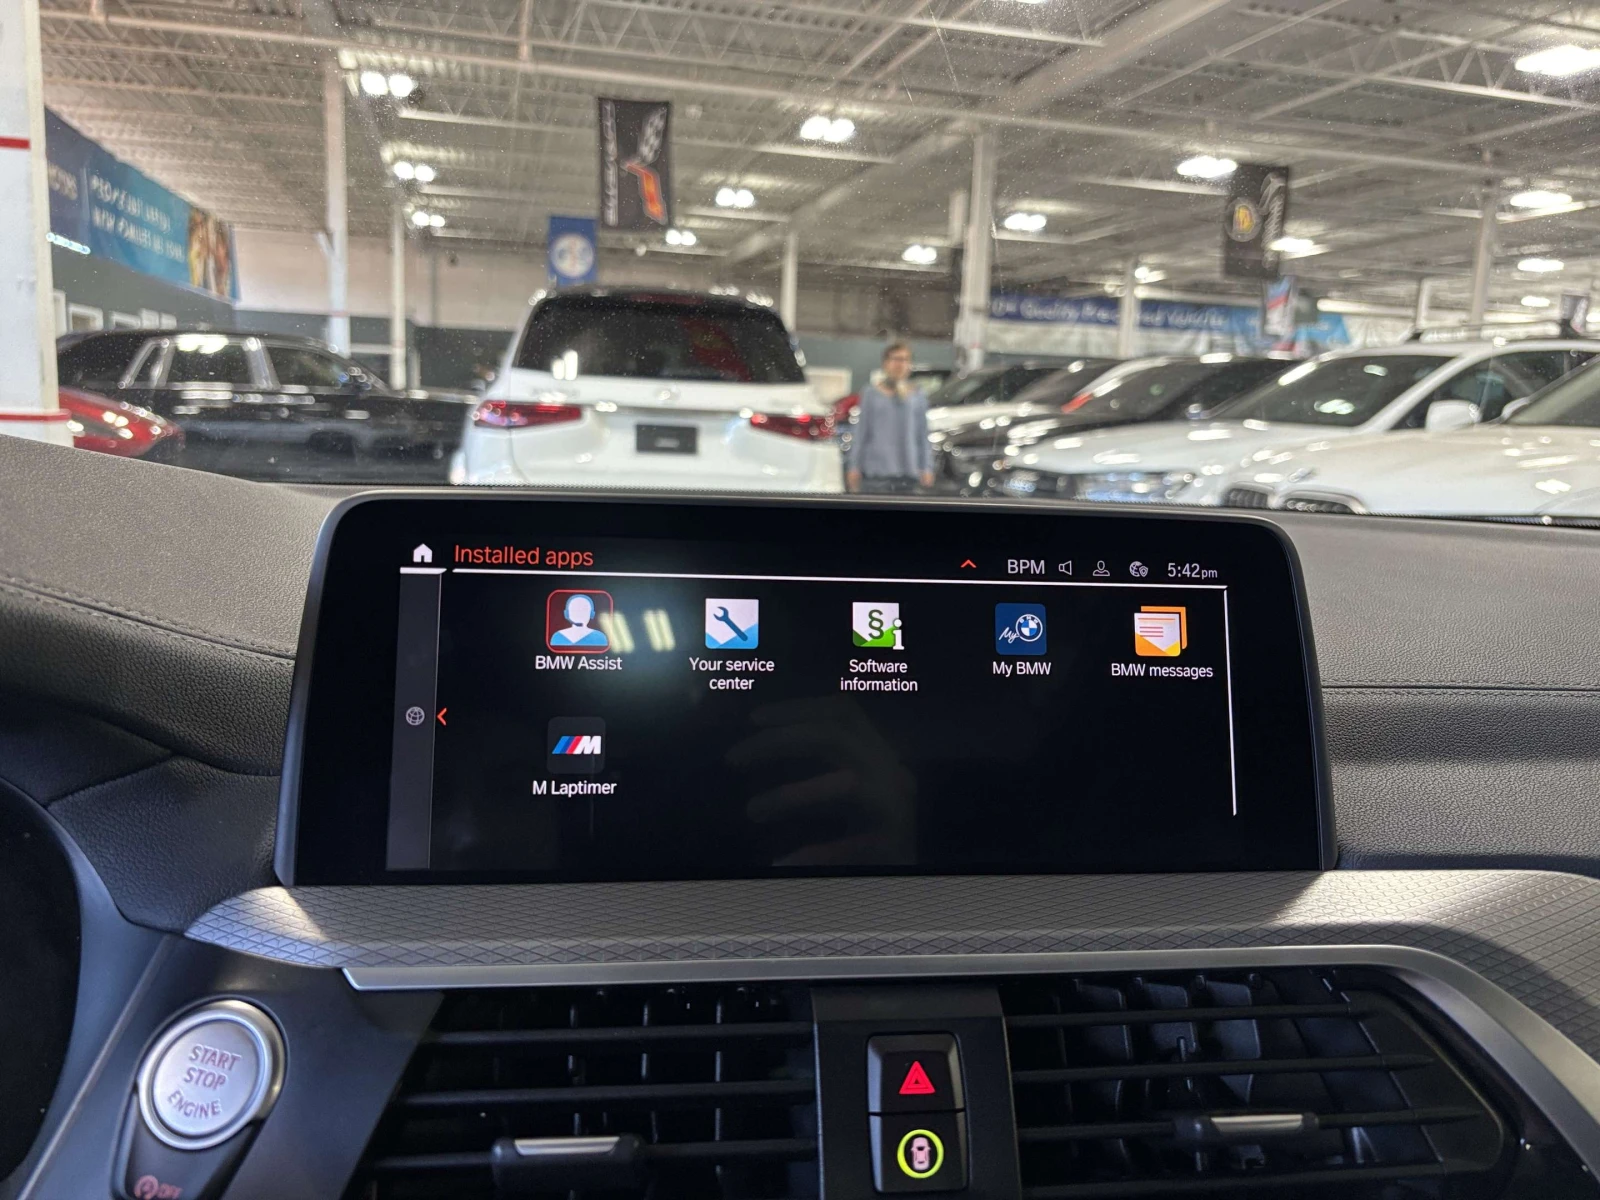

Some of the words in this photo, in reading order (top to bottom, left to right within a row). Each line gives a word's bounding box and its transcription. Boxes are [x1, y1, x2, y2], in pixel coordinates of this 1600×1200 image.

[454, 545, 539, 565] Installed
[546, 551, 594, 568] apps
[1007, 559, 1045, 575] BPM
[535, 655, 575, 670] BMW
[578, 655, 623, 671] Assist
[688, 657, 723, 672] Your
[725, 658, 775, 672] service
[849, 659, 908, 674] Software
[992, 661, 1013, 678] My
[1016, 661, 1052, 676] BMW
[1111, 662, 1146, 677] BMW
[1149, 666, 1214, 680] messages
[708, 677, 755, 691] center
[840, 677, 918, 692] information
[532, 780, 548, 795] M
[551, 780, 617, 798] Laptimer
[189, 1044, 242, 1072] START
[184, 1066, 228, 1091] STOP
[168, 1090, 223, 1119] ENGINE
